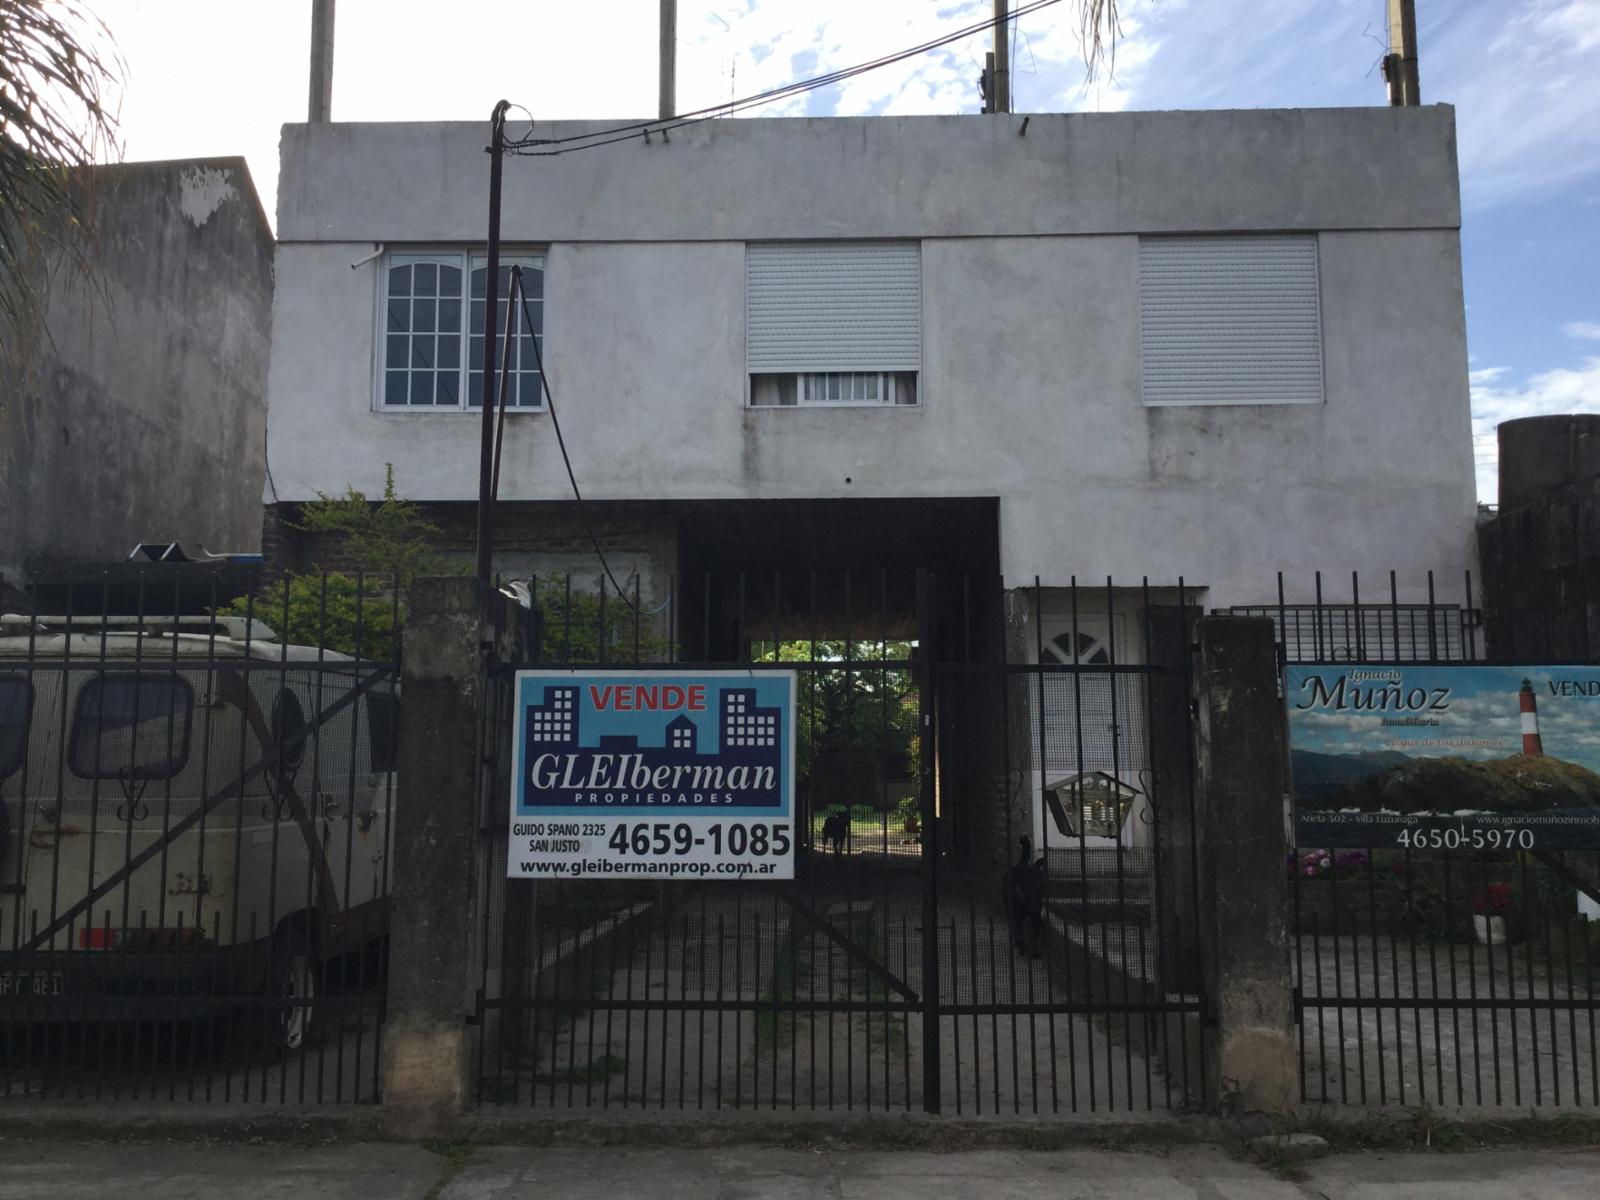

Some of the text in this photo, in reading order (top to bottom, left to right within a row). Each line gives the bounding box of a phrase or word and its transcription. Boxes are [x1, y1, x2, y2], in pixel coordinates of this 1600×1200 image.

[1348, 668, 1402, 683] Ignacio
[589, 685, 706, 712] VENDE
[1296, 674, 1451, 711] Muñoz
[575, 793, 734, 804] PROPIEDADES
[1356, 812, 1374, 823] Villa
[513, 823, 606, 836] GUIDO SPANO 2325
[529, 839, 580, 852] SAN JUSTO
[608, 823, 791, 856] 4659-1085
[1397, 828, 1535, 849] 4650-5970
[520, 858, 777, 876] www.gleibermanprop.com.ar
